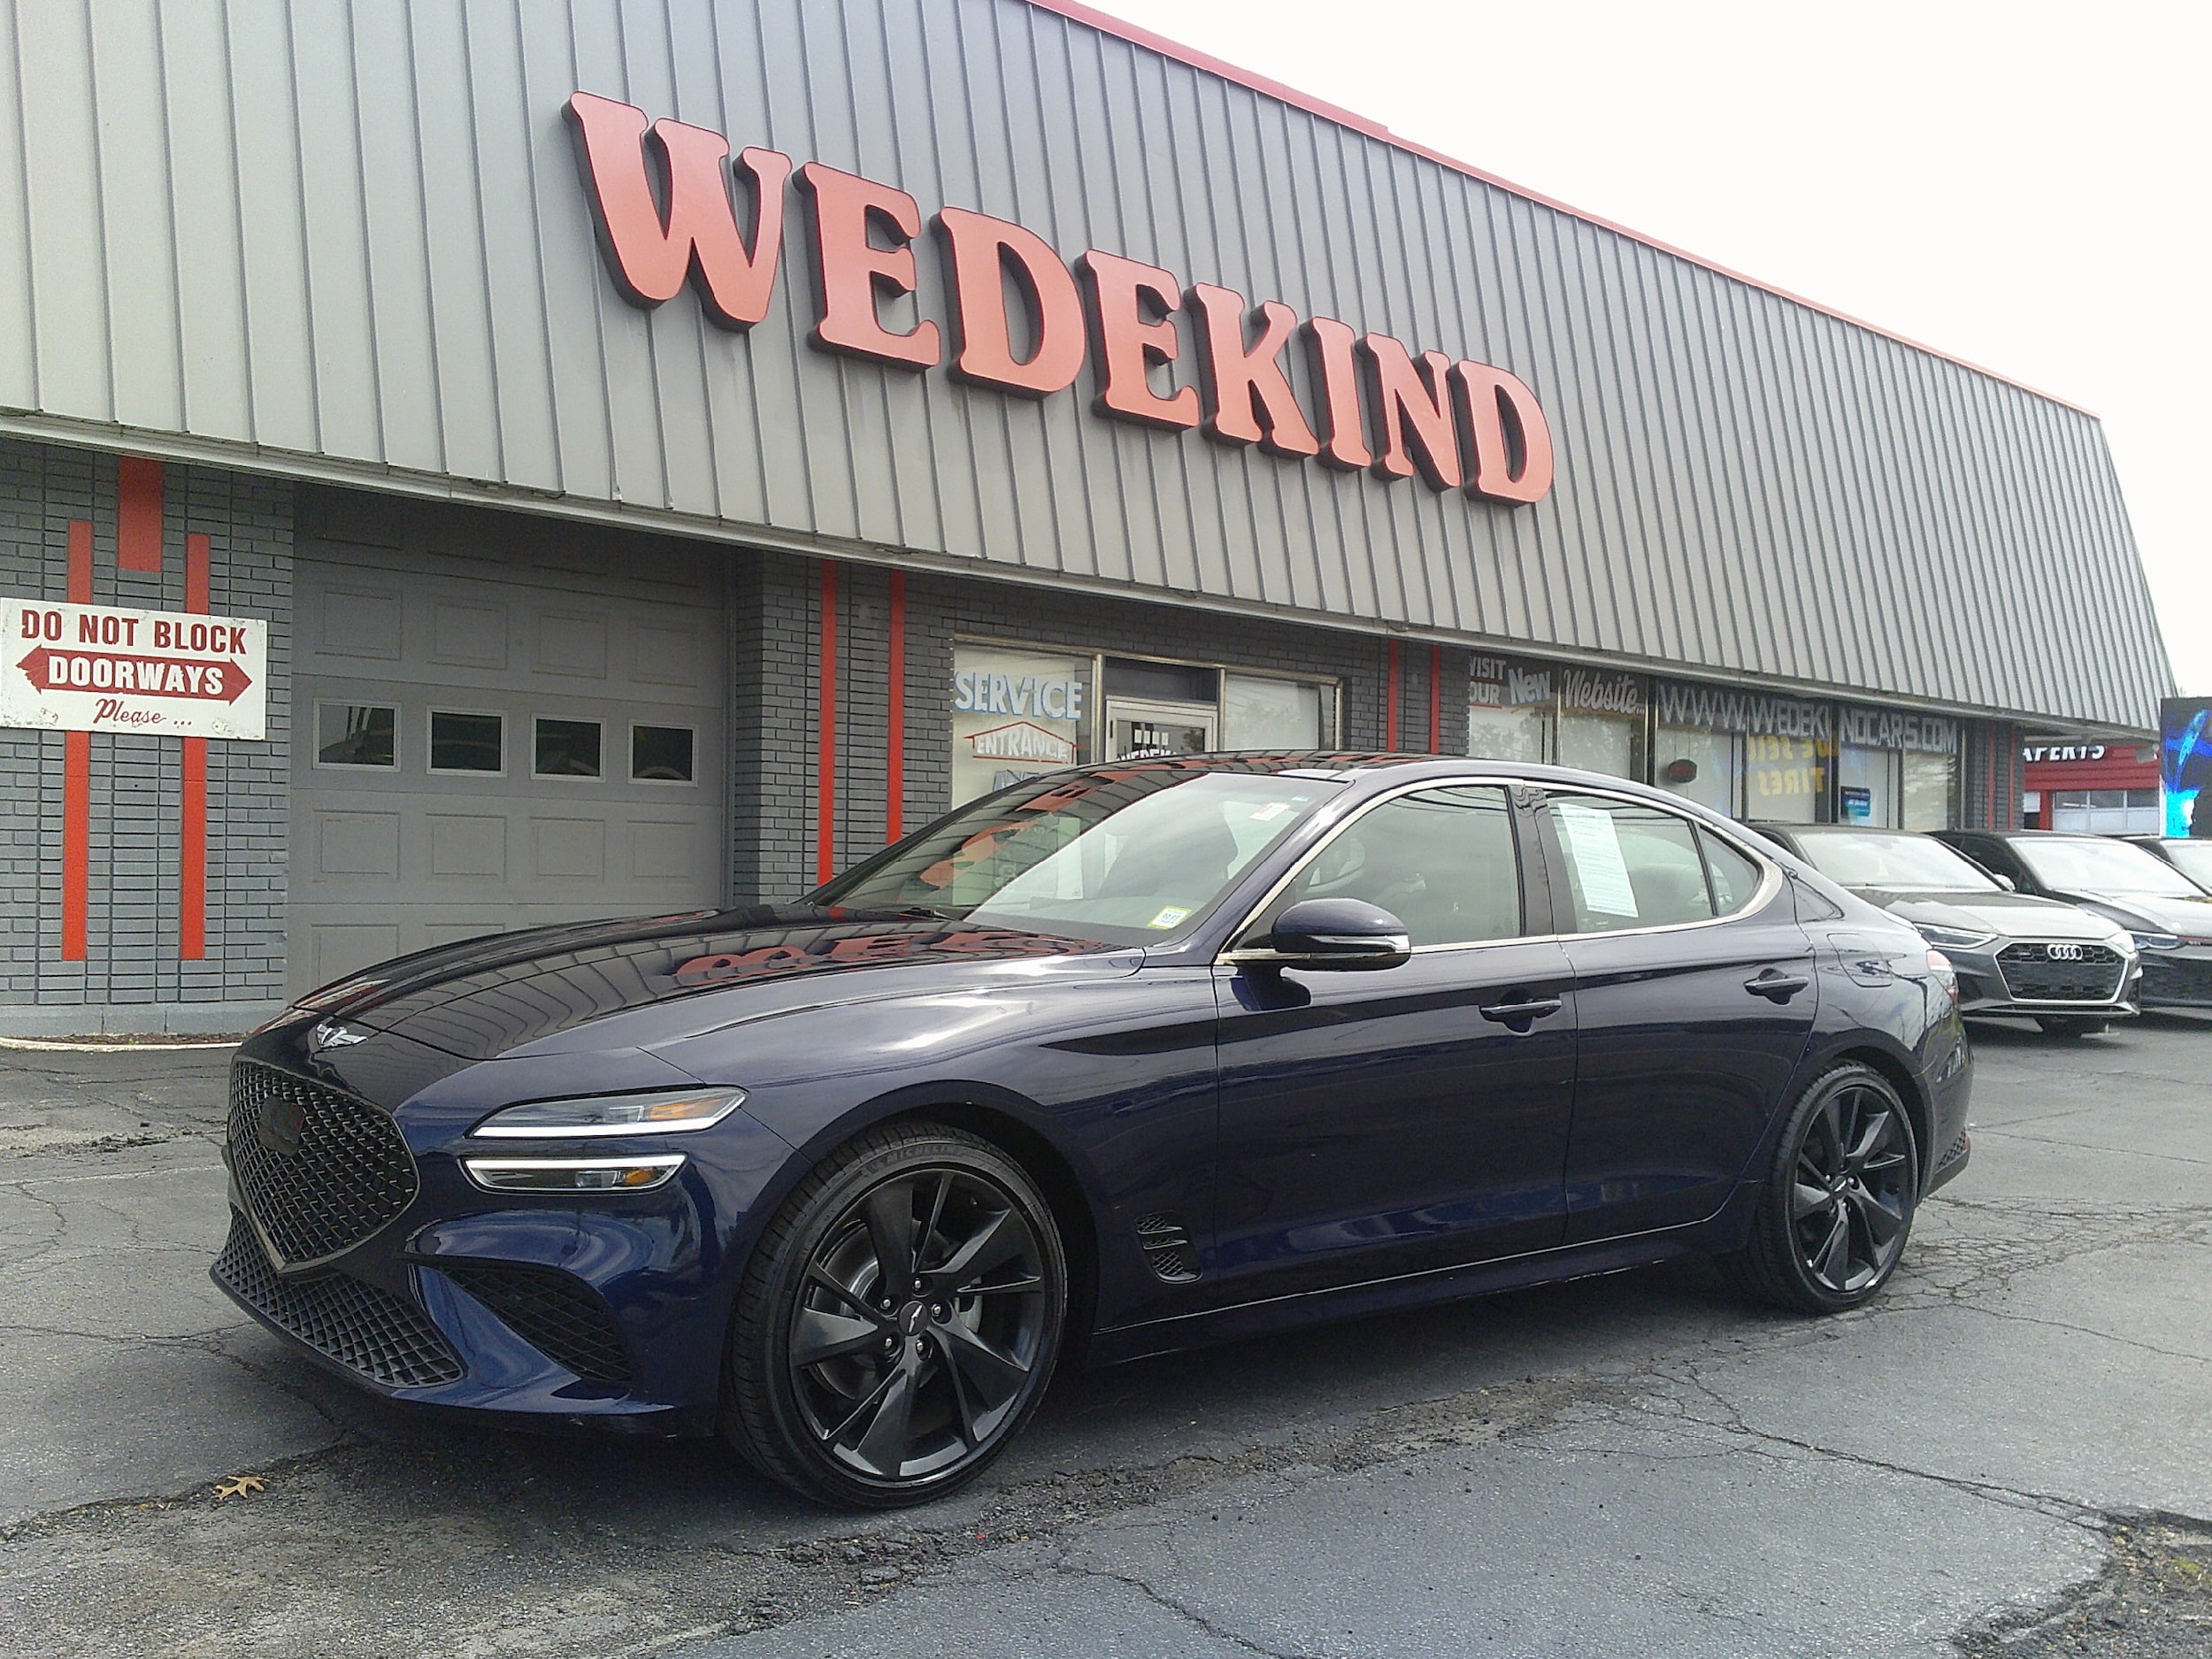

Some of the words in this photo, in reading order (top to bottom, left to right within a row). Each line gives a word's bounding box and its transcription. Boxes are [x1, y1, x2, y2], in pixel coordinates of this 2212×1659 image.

[563, 90, 1554, 504] WEDEKIND
[21, 609, 62, 641] DO
[79, 614, 138, 646] NOT
[154, 620, 247, 655] BLOCK
[48, 655, 223, 695] DOORWAYS
[1469, 656, 1506, 680] VISIT
[1508, 667, 1551, 706] New
[93, 698, 166, 724] Please
[954, 672, 1083, 720] SERVICE
[976, 726, 1069, 759] ENTRANCE
